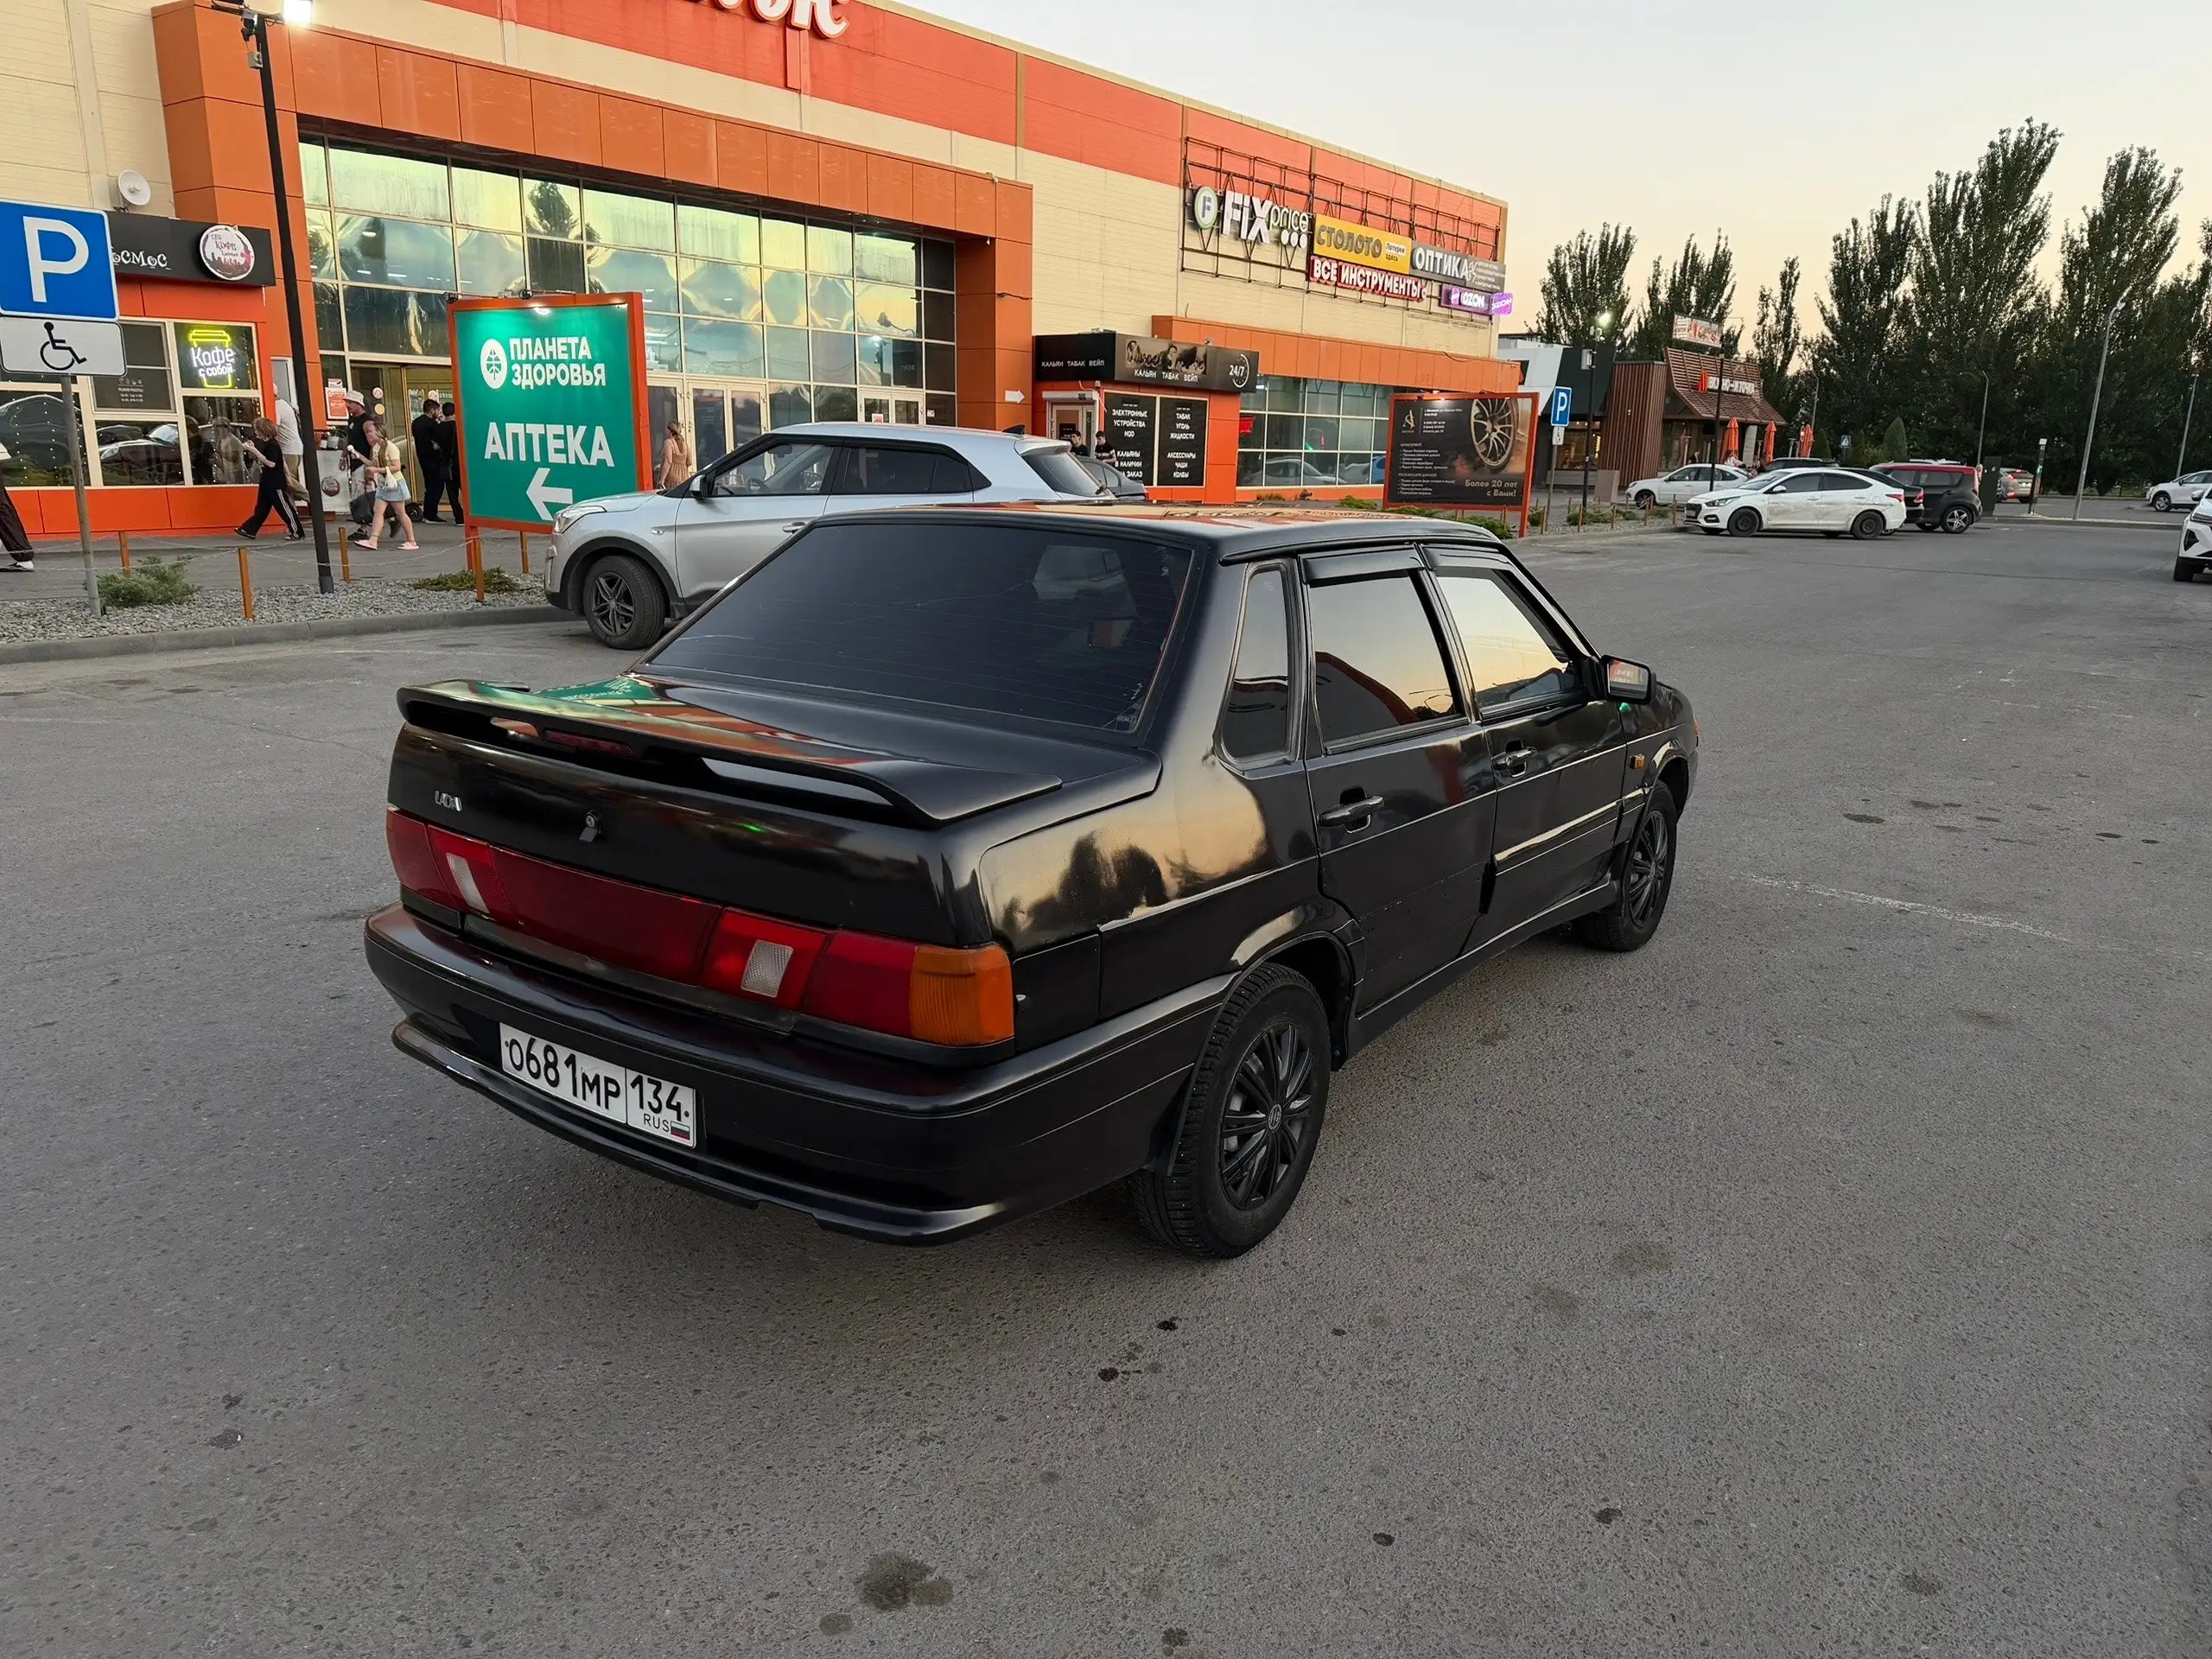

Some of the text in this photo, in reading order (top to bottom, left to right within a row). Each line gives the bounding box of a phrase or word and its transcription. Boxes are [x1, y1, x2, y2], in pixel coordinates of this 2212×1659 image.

[1269, 205, 1309, 232] price
[1316, 225, 1382, 259] СТОЛОТО
[22, 216, 89, 302] P
[1415, 247, 1470, 280] ОПТИКА
[1313, 258, 1421, 299] ВСЕ ИНСТРУМЕНТЫ
[1460, 291, 1485, 308] OZON
[191, 346, 234, 368] Кофе
[509, 336, 593, 361] ПЛАНЕТА
[206, 363, 233, 377] собой
[512, 363, 607, 390] ЗДОРОВЬЯ
[1134, 369, 1198, 382] КАЛЬЯН ТАБАК ВЕЙП
[1229, 365, 1245, 377] 24/7
[1112, 409, 1148, 417] ЭЛЕКТРОННЫЕ
[1556, 391, 1567, 421] P
[1114, 419, 1146, 428] УСТРОЙСТВА
[484, 422, 615, 467] АПТЕКА
[1465, 479, 1490, 487] Более
[630, 1074, 682, 1122] 134
[643, 1113, 670, 1133] RUS
